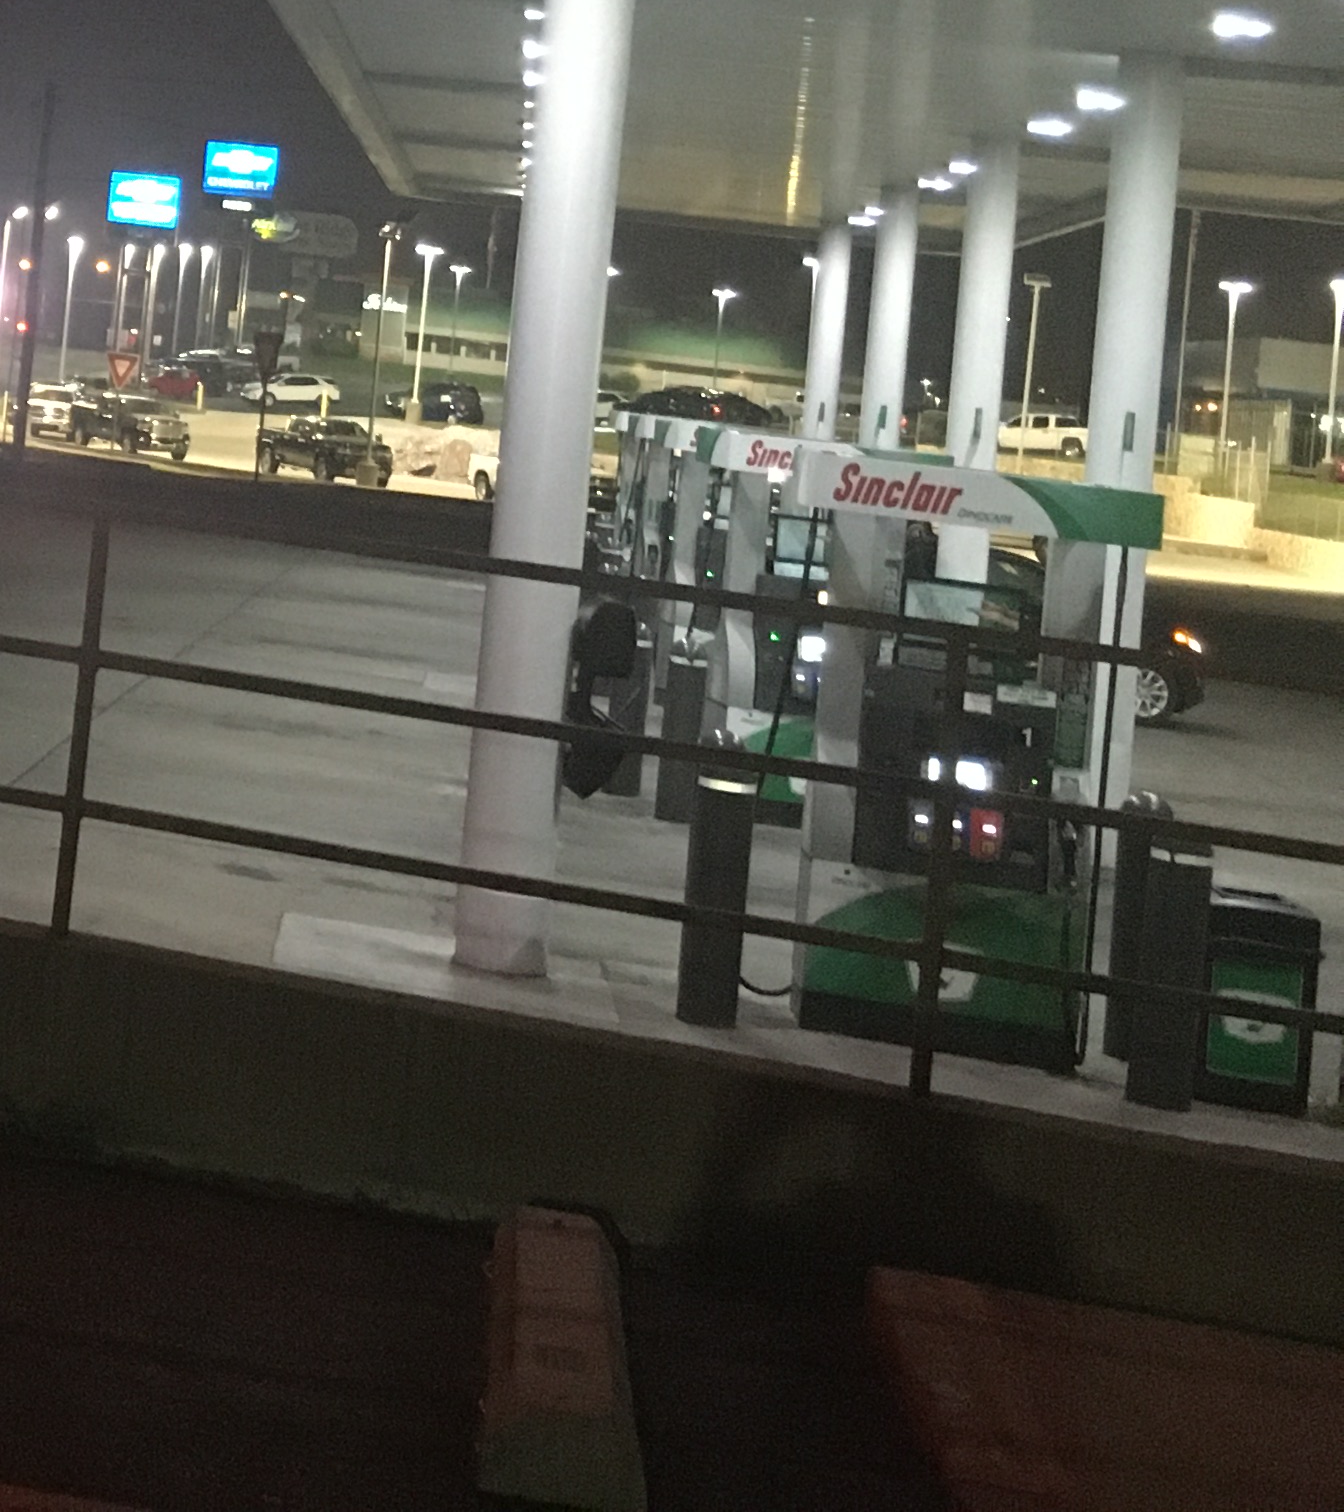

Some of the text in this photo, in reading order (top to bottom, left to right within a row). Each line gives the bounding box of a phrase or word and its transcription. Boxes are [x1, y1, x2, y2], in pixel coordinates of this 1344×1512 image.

[745, 439, 794, 470] Sinc
[832, 462, 964, 517] Sinclair
[1020, 726, 1033, 748] 1
